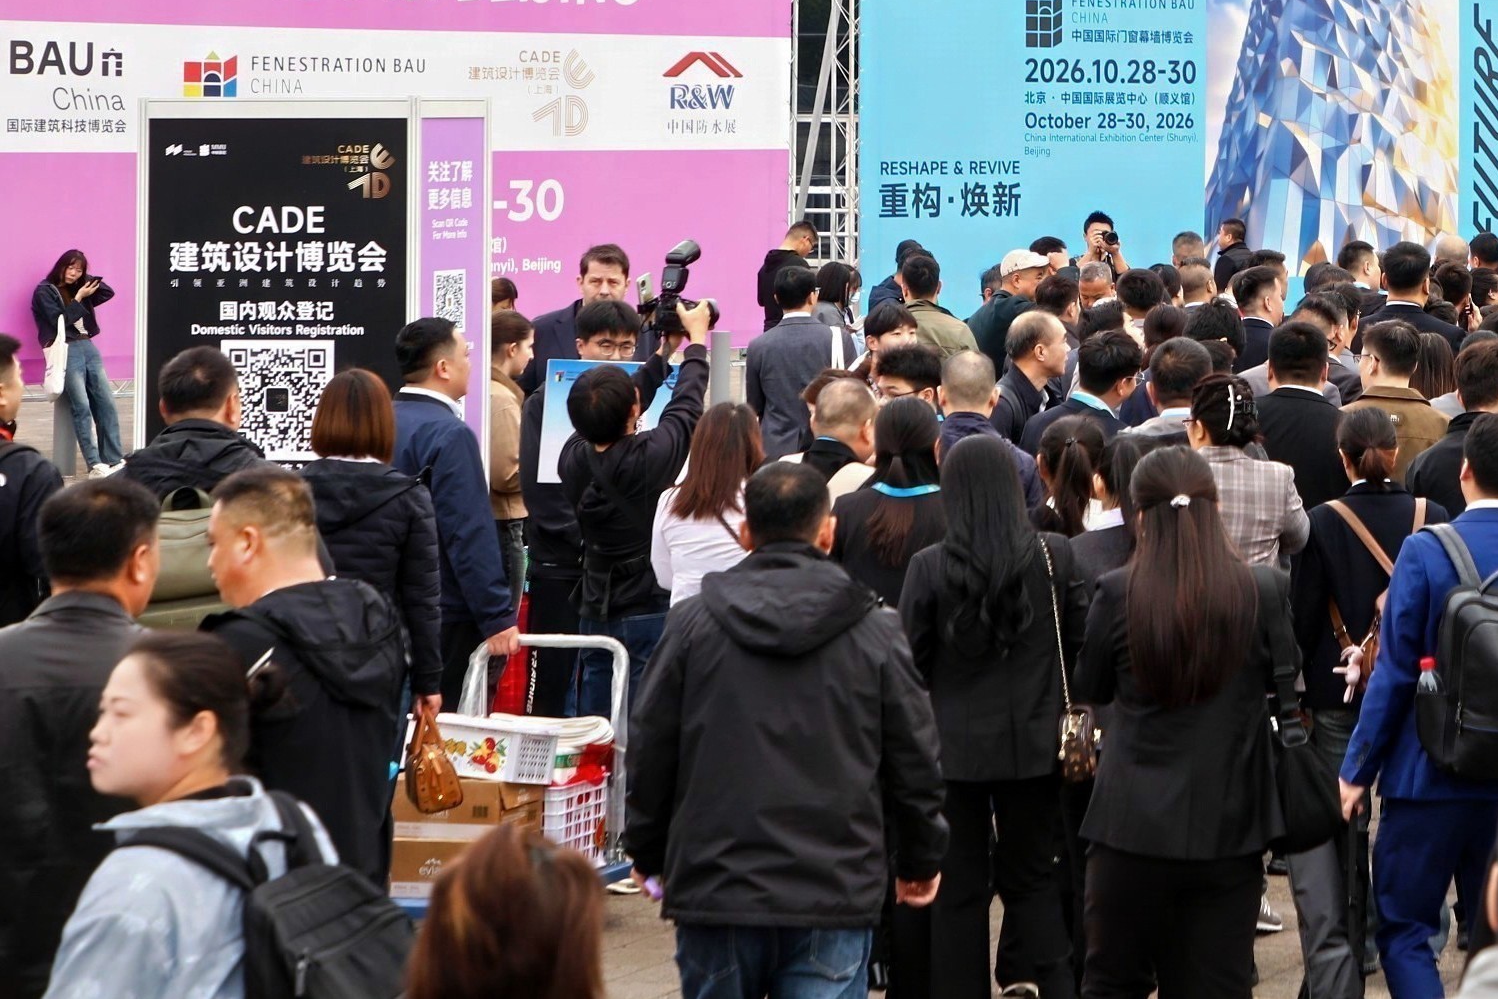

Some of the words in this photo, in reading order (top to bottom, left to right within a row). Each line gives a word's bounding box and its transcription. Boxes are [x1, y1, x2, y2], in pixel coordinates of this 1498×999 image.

[1071, 12, 1108, 24] CHINA
[1071, 29, 1193, 44] 中国国际门窗幕墙博览会
[9, 40, 94, 76] BAU
[251, 55, 386, 74] FENESTRATION
[393, 58, 427, 74] BAU
[519, 50, 561, 63] CADE
[468, 66, 560, 81] 建筑设计博览会
[1024, 57, 1197, 85] 2026.10.28-30
[250, 78, 303, 94] CHINA
[52, 86, 125, 111] China
[669, 83, 735, 109] R&W
[6, 118, 127, 134] 国际建筑科技博览会
[666, 118, 736, 134] 中国防水展
[1024, 111, 1092, 129] October
[1156, 112, 1194, 129] 2026
[1024, 132, 1047, 143] China
[1049, 132, 1097, 143] International
[1099, 132, 1137, 143] Exhibition
[1138, 133, 1164, 143] Center
[337, 144, 370, 154] CADE
[1024, 146, 1051, 158] Beijing
[428, 160, 473, 182] 关注了解
[880, 160, 948, 176] RESHAPE
[953, 160, 964, 175] &
[969, 160, 1021, 175] REVIVE
[427, 187, 473, 210] 更多信息
[232, 205, 325, 234] CADE
[169, 240, 387, 273] 建筑设计博览会
[522, 257, 562, 275] Beijing
[219, 301, 335, 321] 国内观众登记
[191, 323, 246, 336] Domestic
[249, 323, 292, 336] Visitors
[295, 323, 365, 338] Registration
[526, 649, 538, 715] TRAINING
